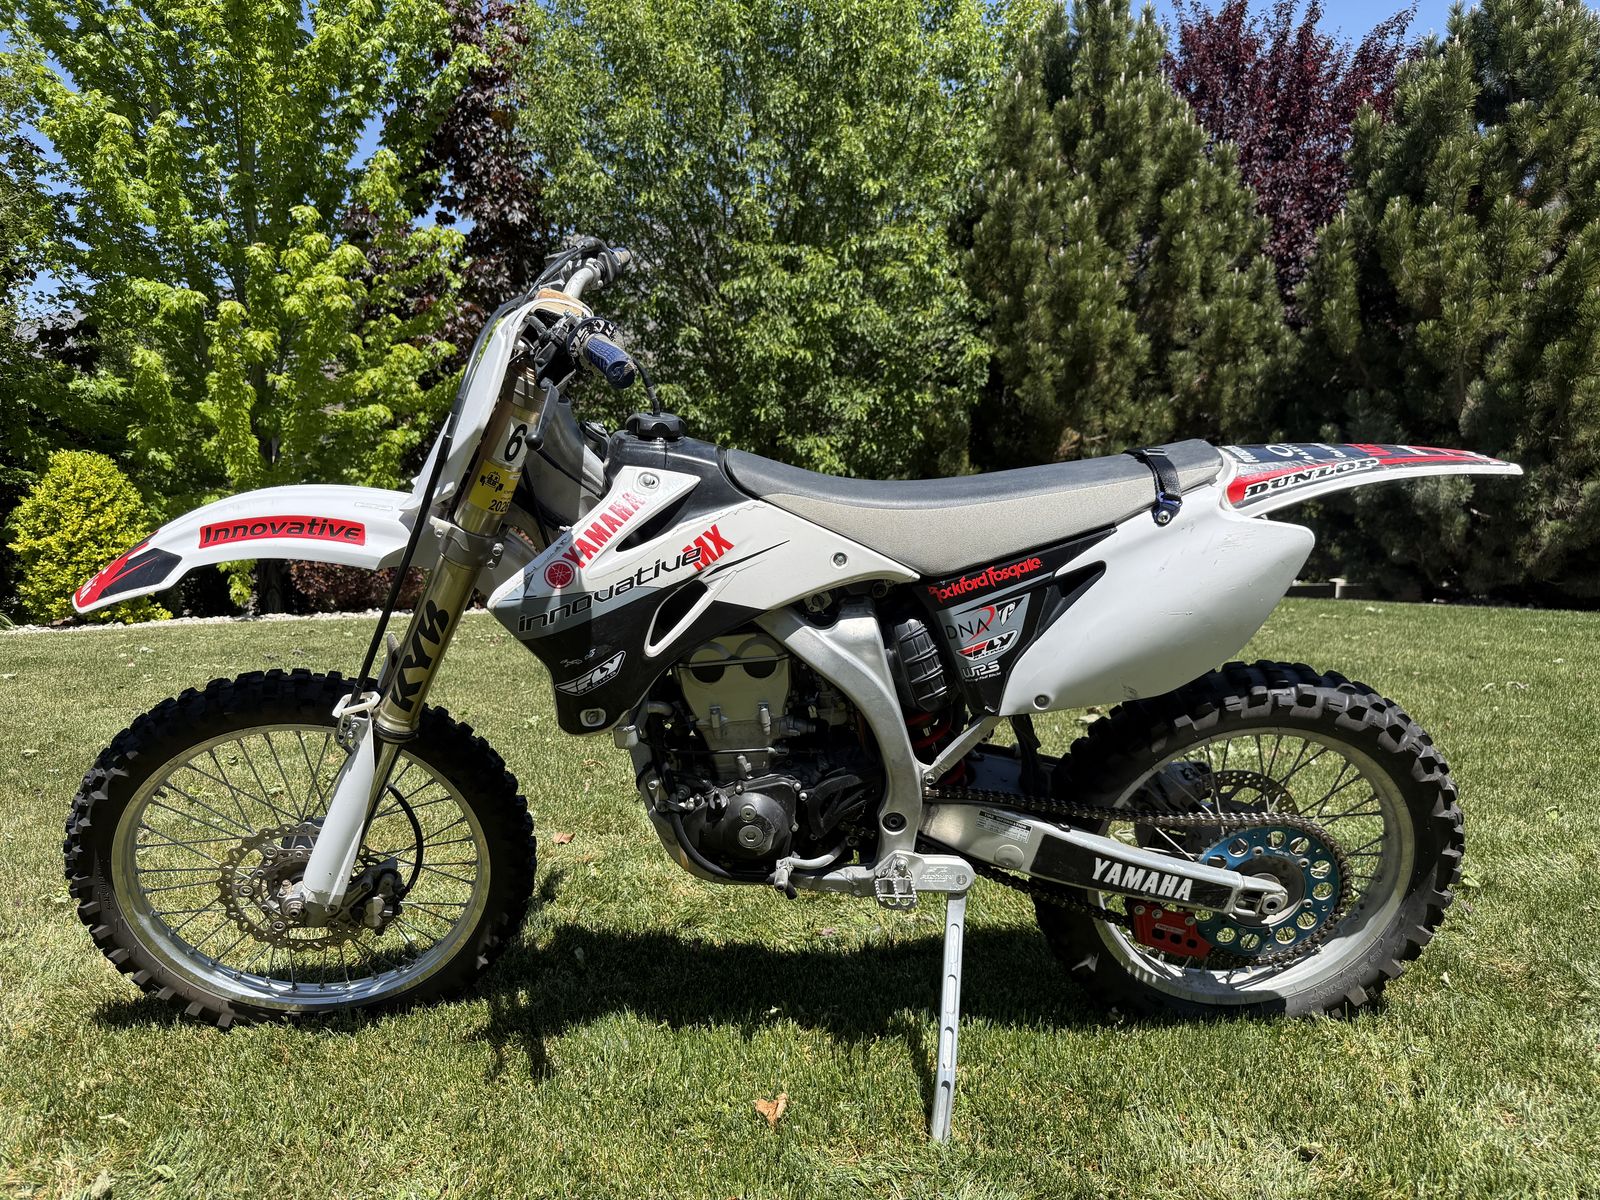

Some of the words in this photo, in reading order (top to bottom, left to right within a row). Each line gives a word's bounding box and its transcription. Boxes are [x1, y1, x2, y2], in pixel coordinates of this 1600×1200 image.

[504, 424, 527, 461] 6
[1244, 458, 1379, 499] DUNLOP
[203, 518, 362, 544] Innovative
[562, 492, 645, 569] YAMAHA
[518, 546, 703, 632] innovative
[682, 524, 734, 572] MX
[928, 572, 987, 603] Rockford
[986, 557, 1042, 587] Fosgate
[946, 618, 990, 640] DNA
[389, 600, 450, 713] KYB
[556, 652, 624, 693] FLY
[962, 660, 1000, 678] WPS
[1092, 857, 1193, 901] YAMAHA
